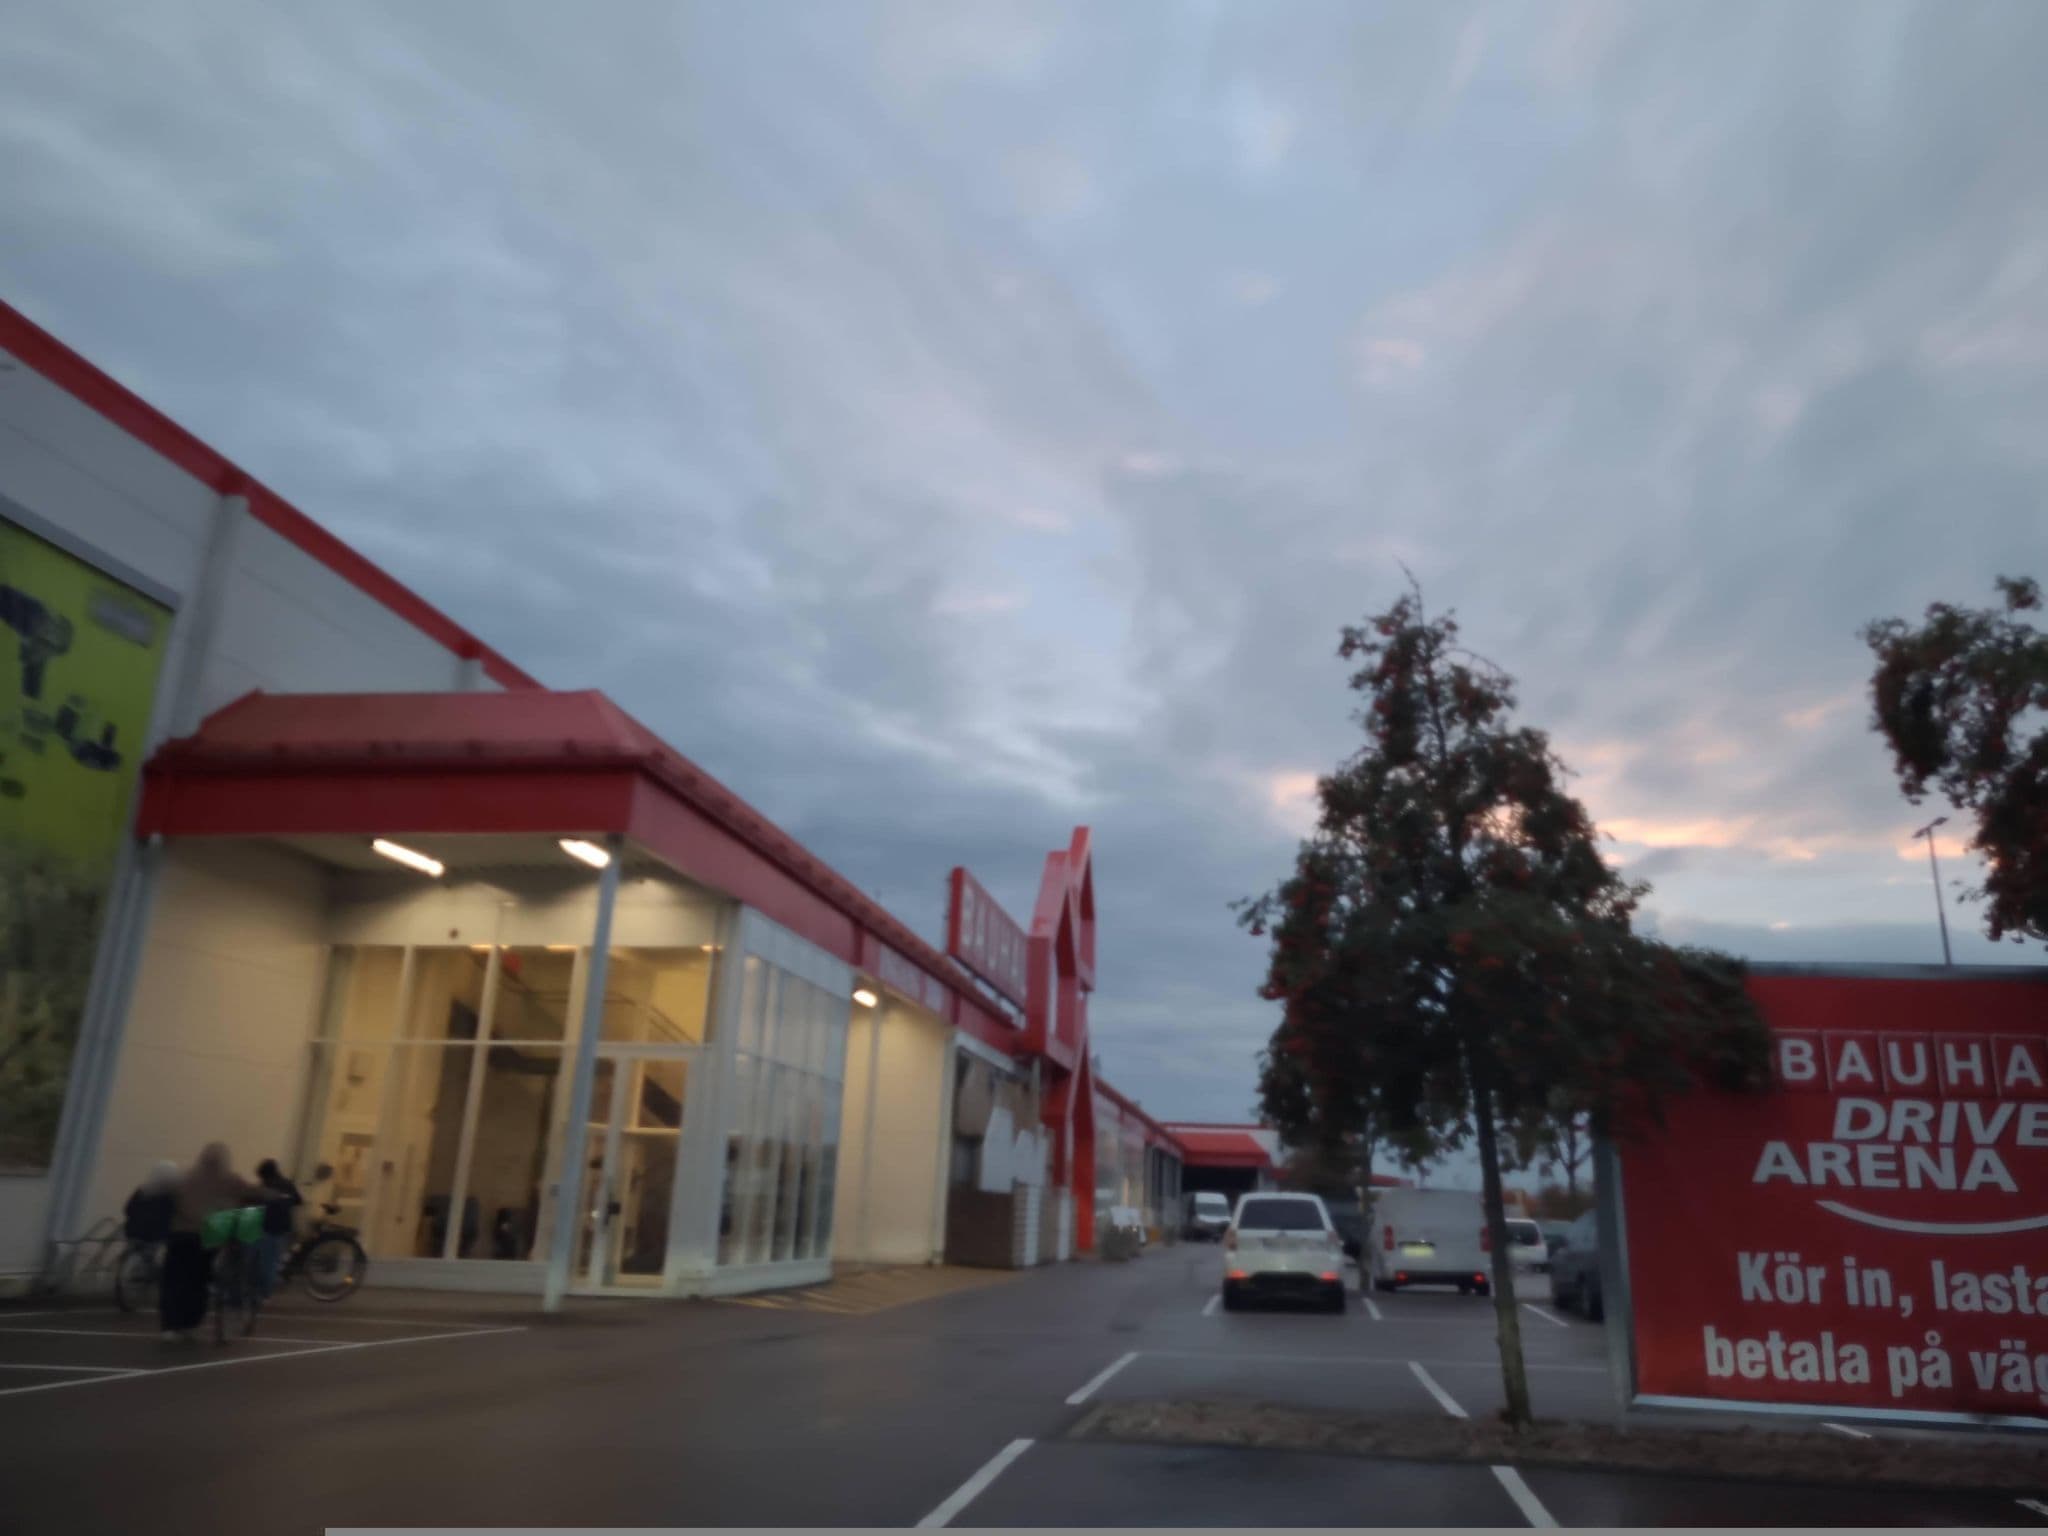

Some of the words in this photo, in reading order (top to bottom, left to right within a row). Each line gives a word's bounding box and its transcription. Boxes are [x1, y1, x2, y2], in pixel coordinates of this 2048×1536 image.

[1780, 1038, 2042, 1087] BAUHA
[1833, 1098, 2048, 1147] DRIVE
[1755, 1142, 2018, 1192] ARENA
[1738, 1252, 1825, 1304] Kör
[1844, 1257, 1914, 1317] in,
[1703, 1326, 1870, 1384] betala
[1888, 1330, 1952, 1398] på
